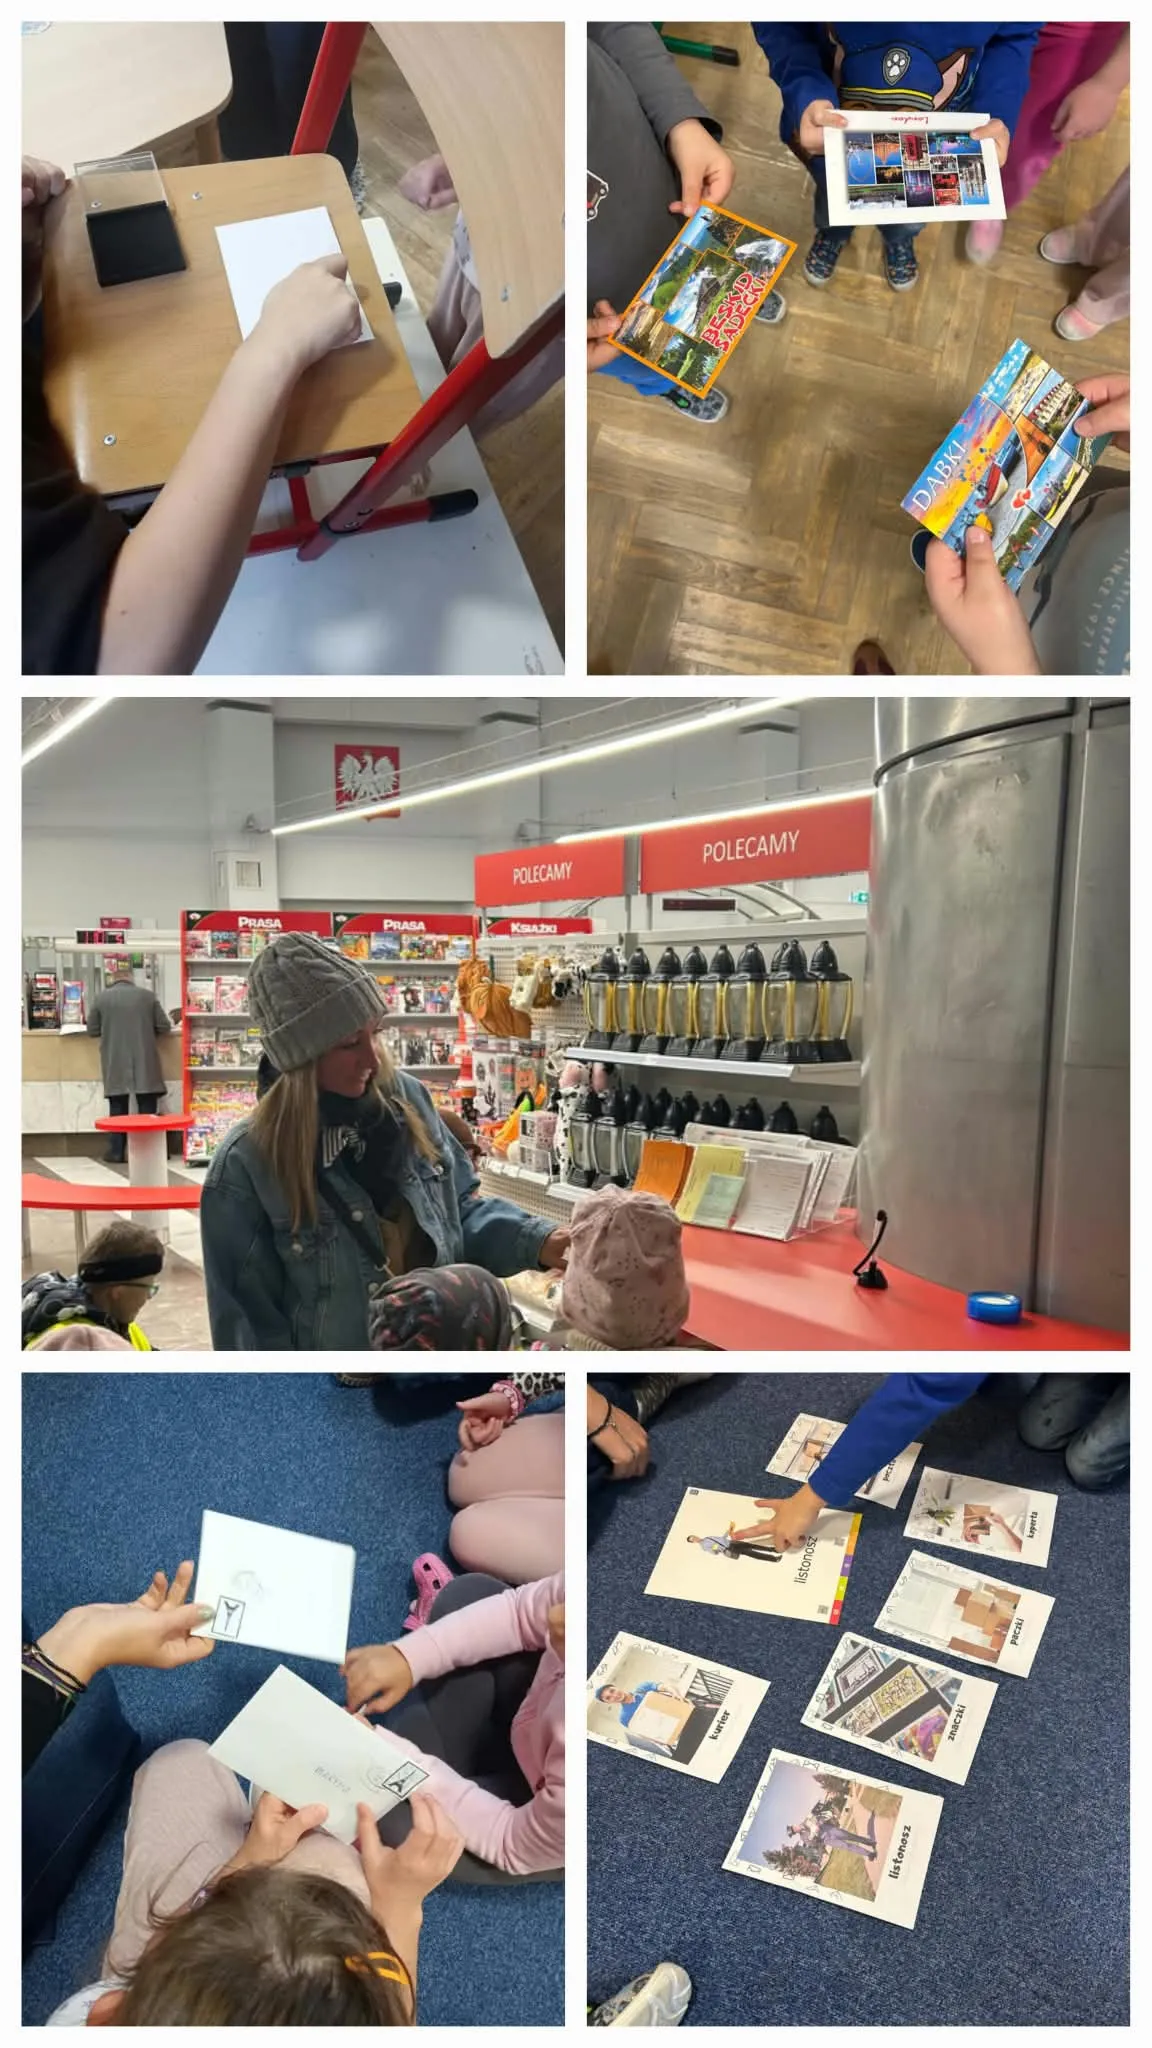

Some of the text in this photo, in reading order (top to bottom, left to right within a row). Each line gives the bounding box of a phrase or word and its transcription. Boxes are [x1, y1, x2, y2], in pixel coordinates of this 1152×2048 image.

[700, 271, 754, 345] BESKID
[703, 829, 800, 864] POLECAMY
[513, 861, 573, 885] POLECAMY
[238, 916, 282, 928] PRASA
[383, 918, 426, 931] PRASA
[794, 1535, 818, 1584] listonosz
[1009, 1617, 1025, 1646] paczki
[708, 1709, 731, 1741] kurier
[947, 1704, 967, 1742] znaczki
[887, 1824, 912, 1880] listonosz
